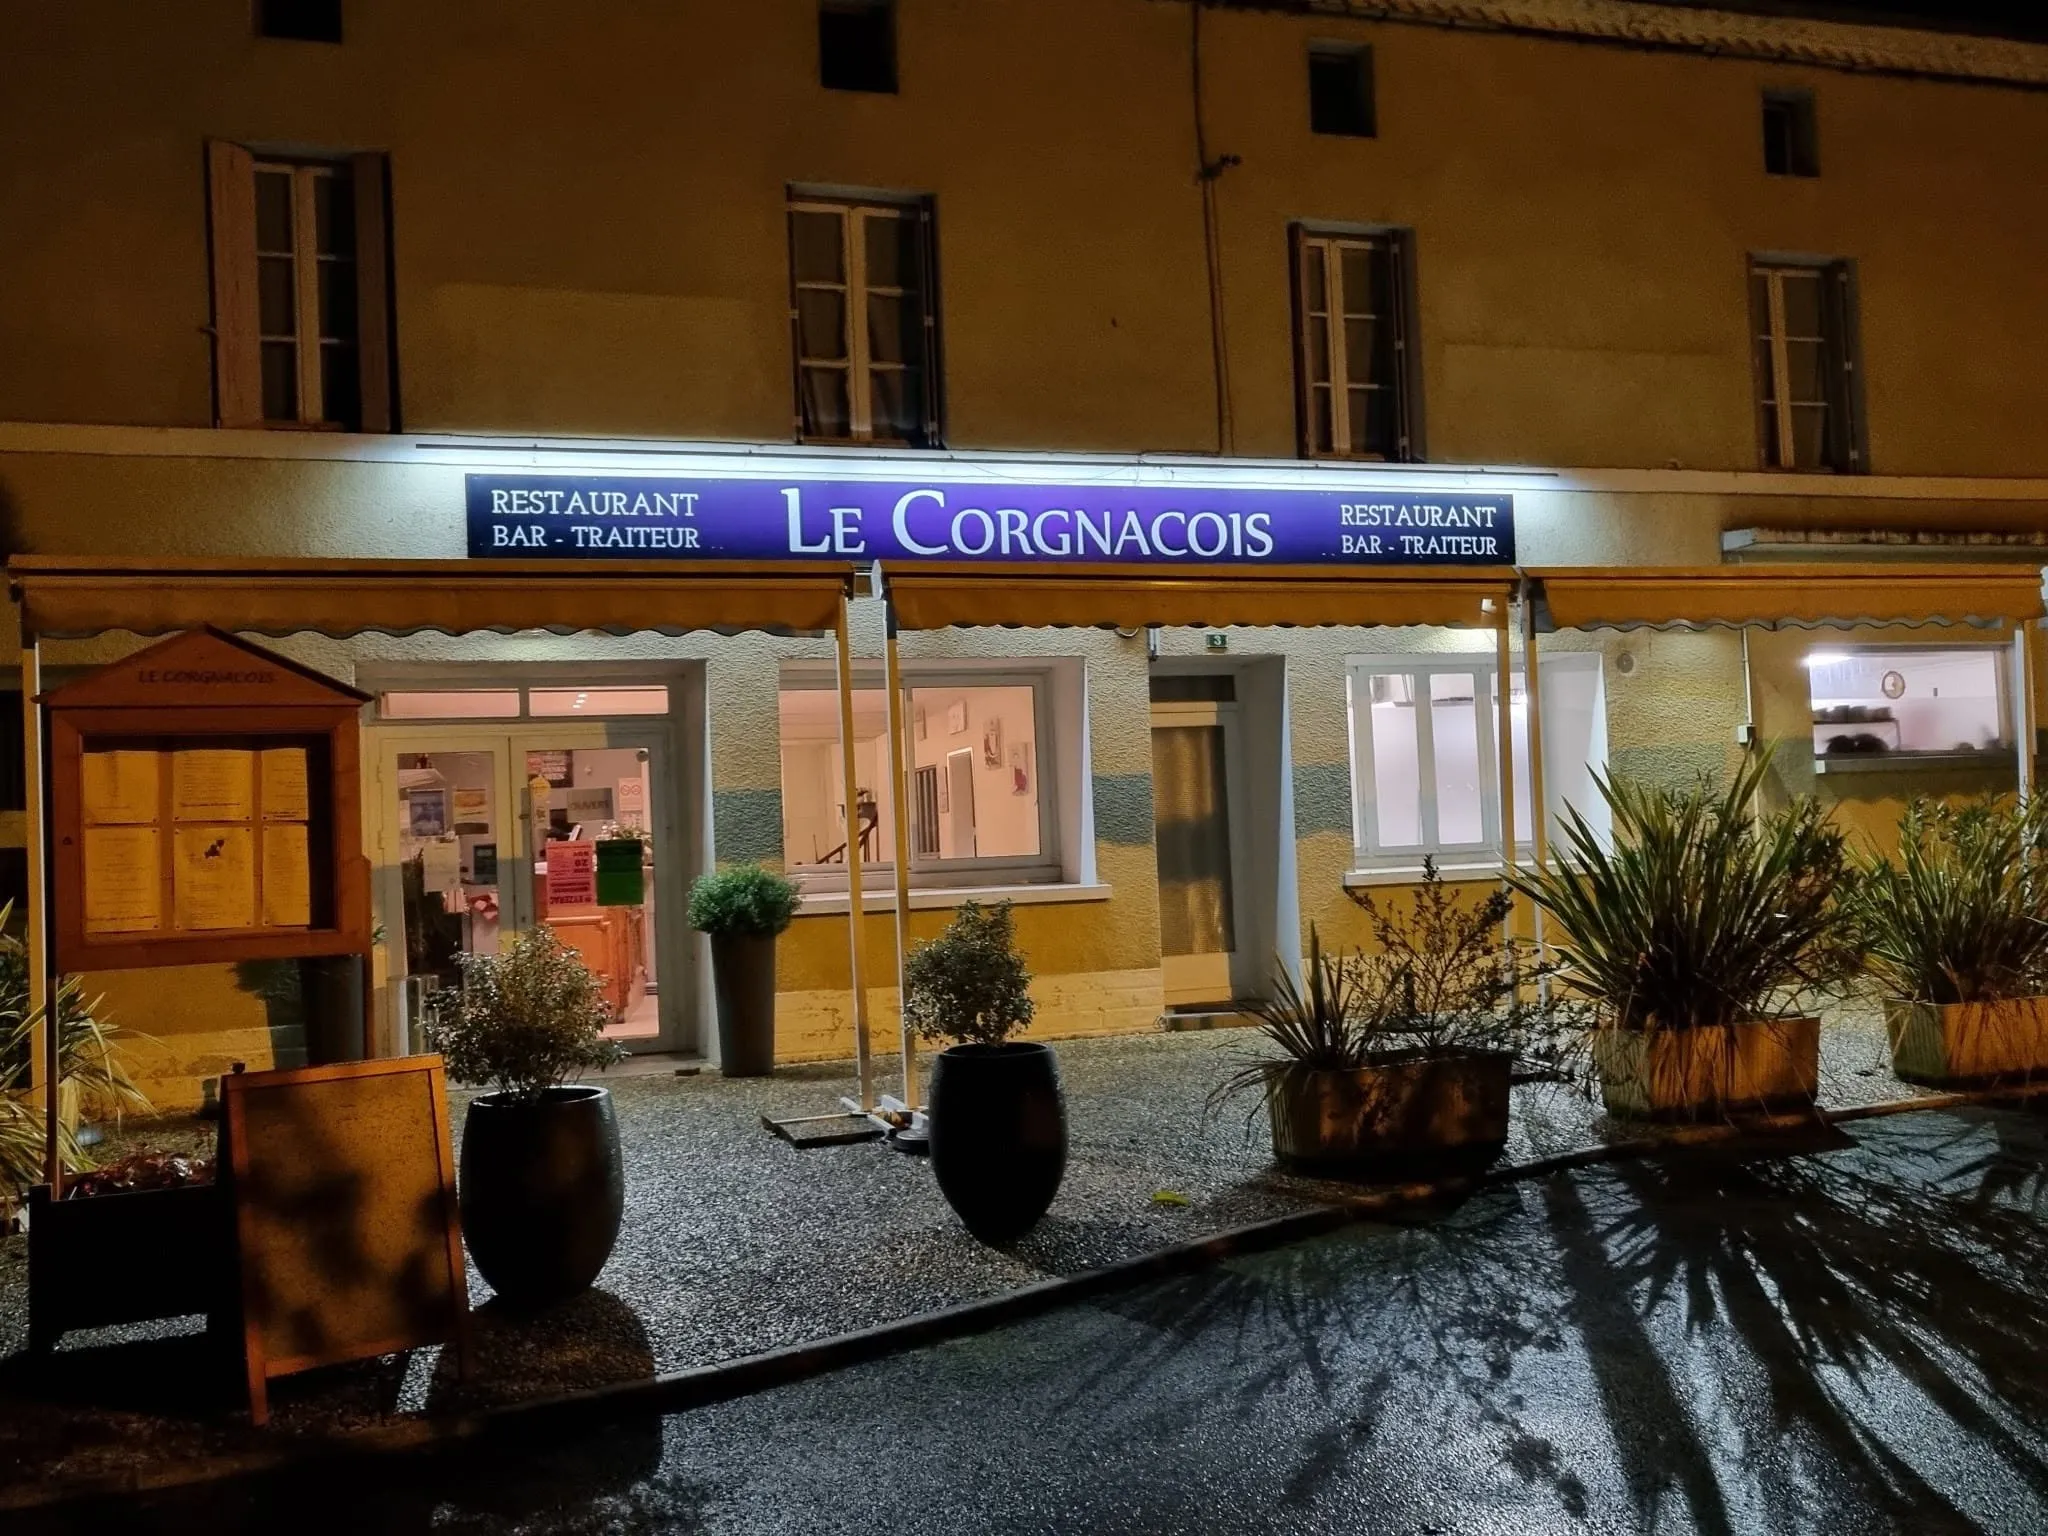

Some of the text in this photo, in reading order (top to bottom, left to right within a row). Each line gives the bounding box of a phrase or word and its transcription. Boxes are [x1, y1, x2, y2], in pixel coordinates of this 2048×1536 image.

[491, 489, 699, 517] RESTAURANT
[781, 487, 1274, 557] LE CORGNACOIS
[1340, 504, 1497, 528] RESTAURANT
[492, 525, 548, 547] BAR
[571, 526, 701, 548] TRAITEUR
[1341, 534, 1383, 554] BAR
[1400, 535, 1498, 555] TRAITEUR
[1213, 635, 1222, 646] 3
[138, 670, 158, 684] LE
